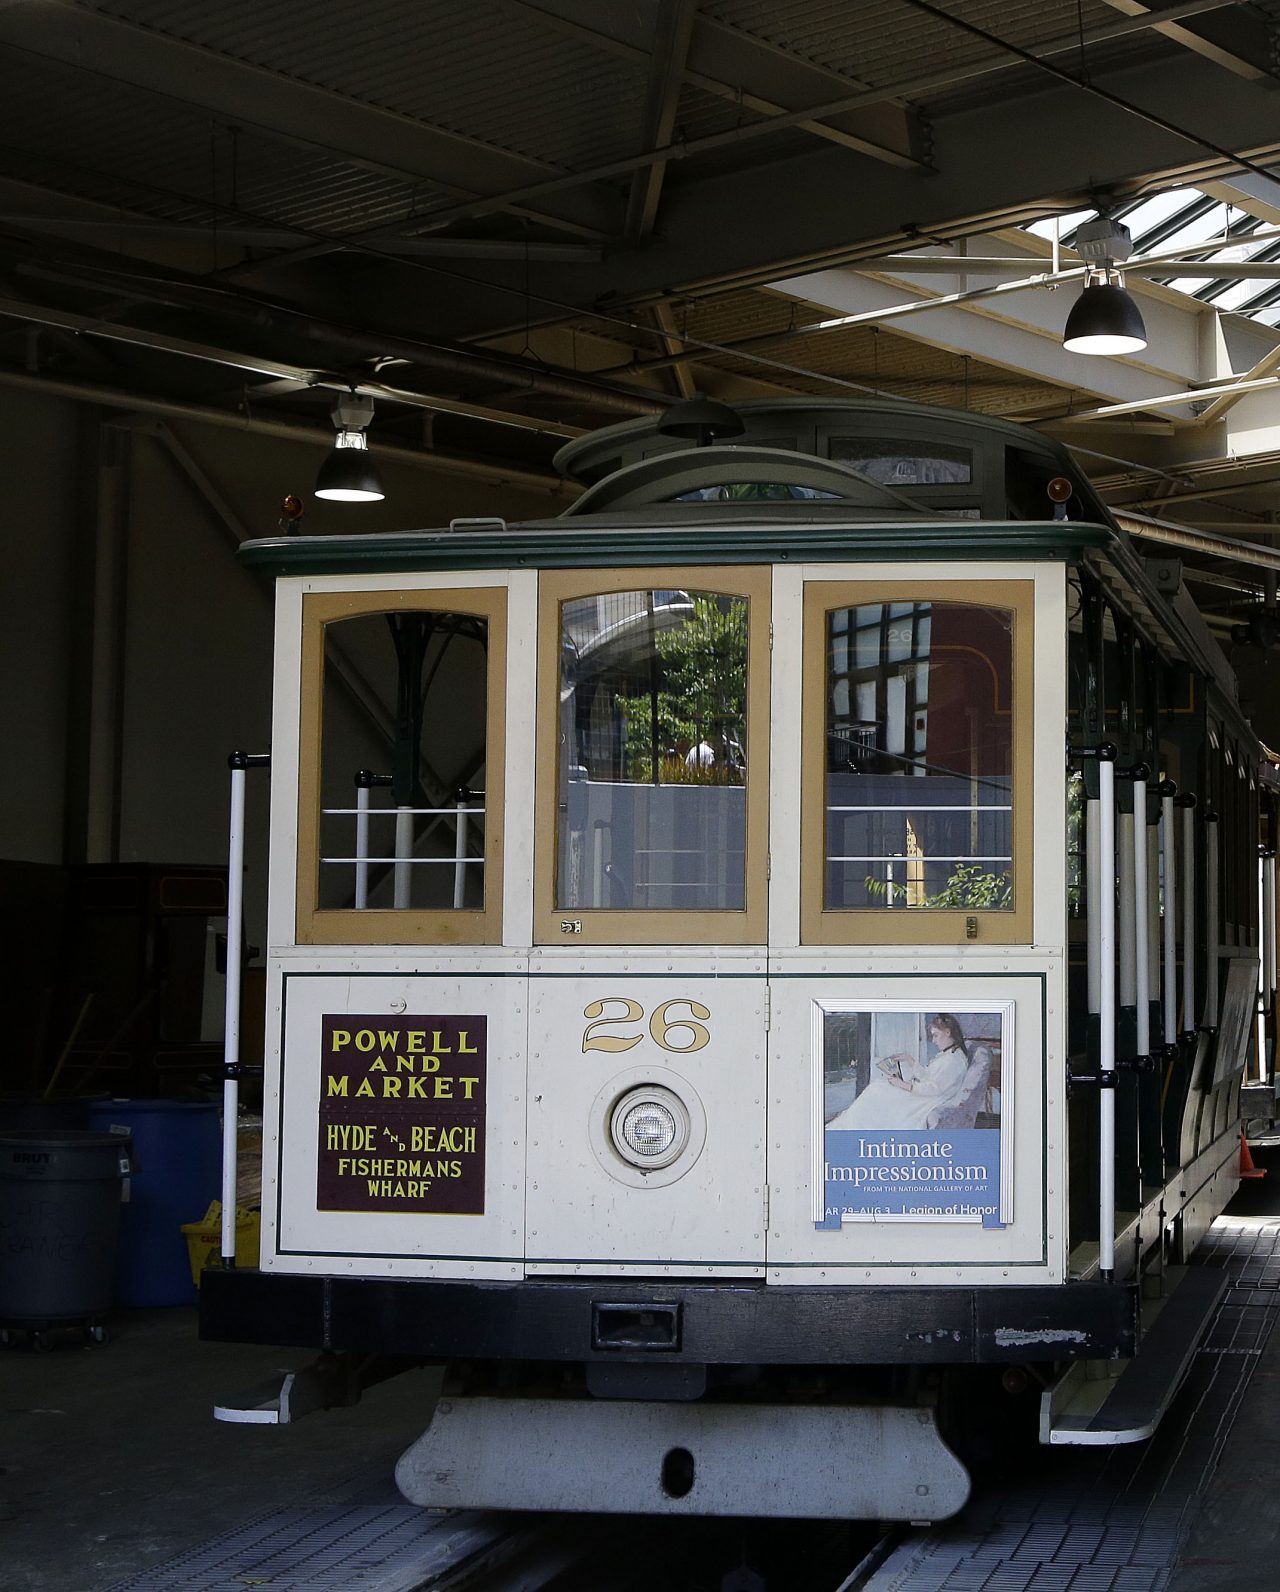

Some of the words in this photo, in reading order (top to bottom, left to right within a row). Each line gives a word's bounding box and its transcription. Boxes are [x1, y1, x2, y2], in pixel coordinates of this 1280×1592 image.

[581, 996, 711, 1054] 26
[331, 1029, 478, 1054] POWELL
[368, 1055, 441, 1073] AND
[326, 1075, 480, 1099] MARKET
[327, 1124, 377, 1151] HYDE
[383, 1126, 406, 1152] AND
[411, 1126, 476, 1153] BEACH
[858, 1137, 953, 1158] Intimate
[338, 1158, 462, 1178] FISHERMANS
[824, 1160, 988, 1187] Impressionism
[367, 1180, 432, 1198] WHARF
[825, 1207, 839, 1216] AR
[902, 1204, 942, 1215] Legion
[946, 1204, 957, 1215] of
[960, 1204, 997, 1215] Honor
